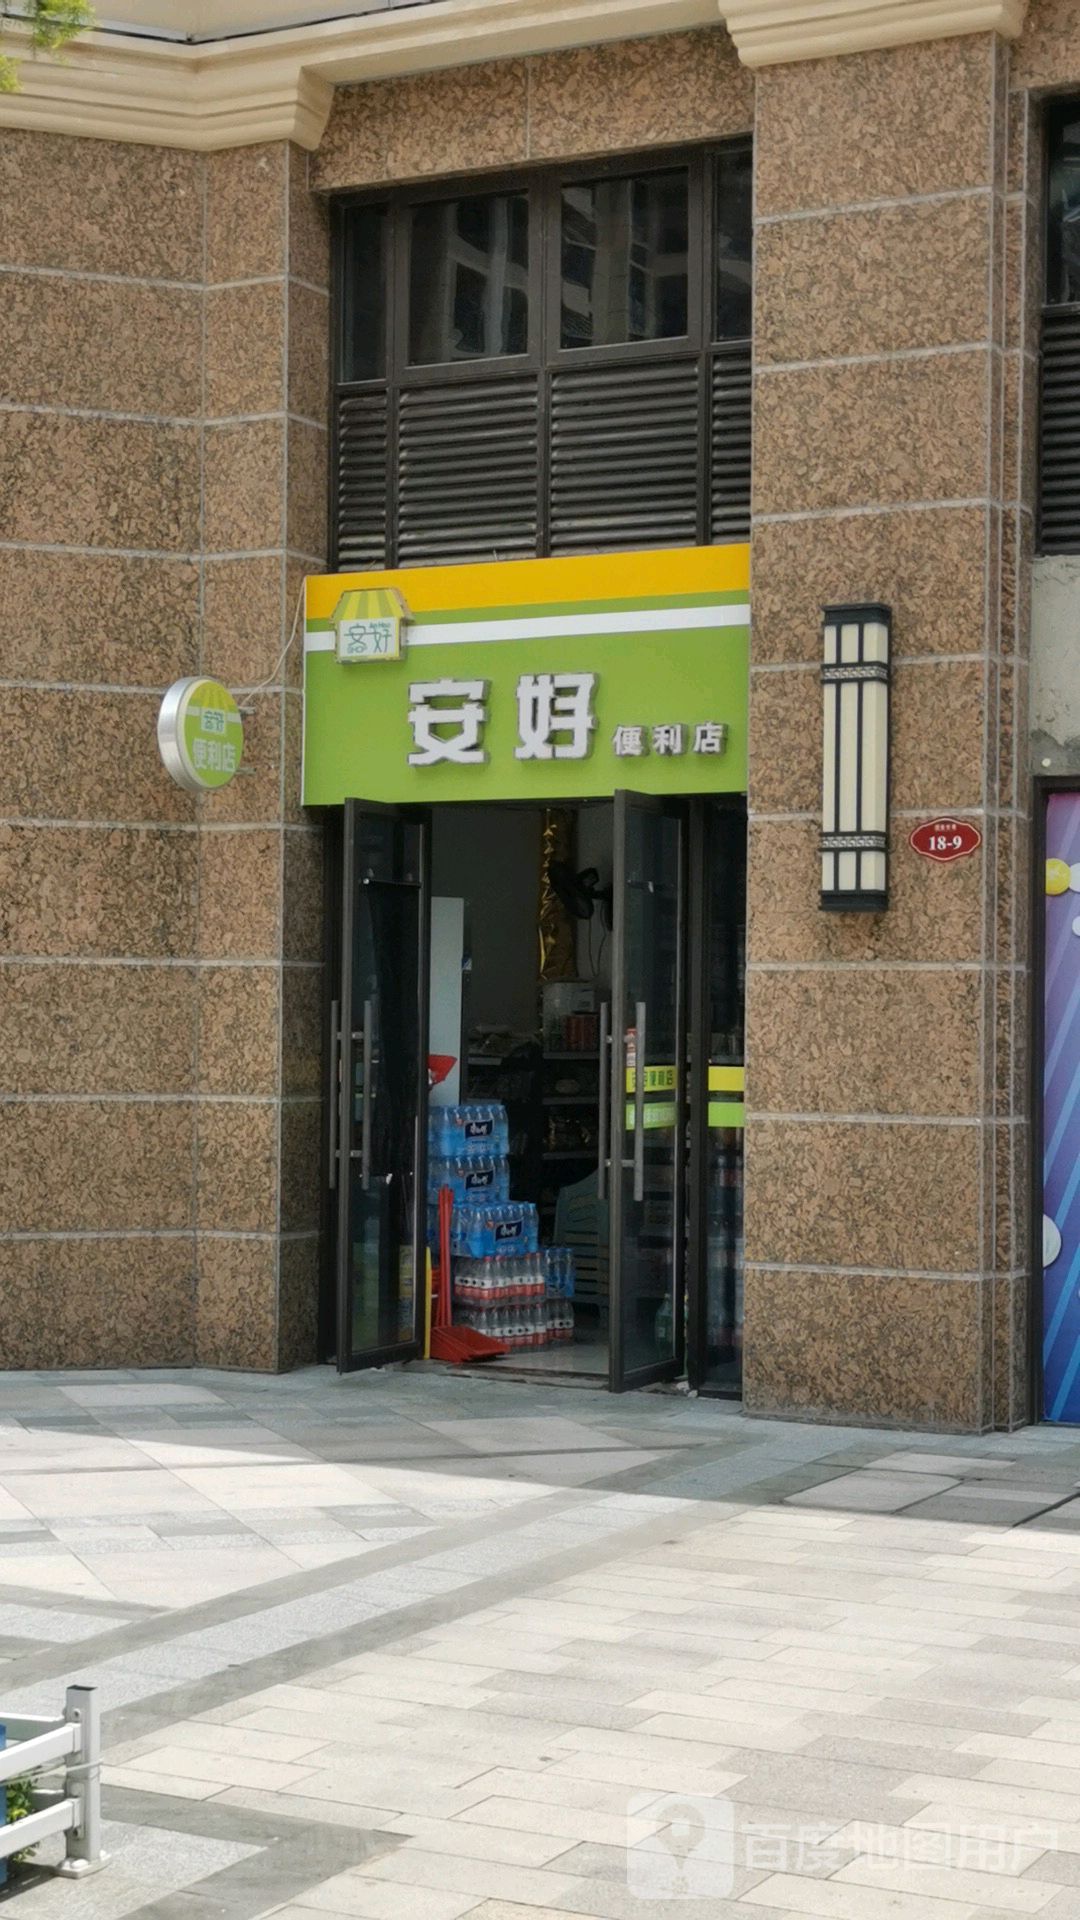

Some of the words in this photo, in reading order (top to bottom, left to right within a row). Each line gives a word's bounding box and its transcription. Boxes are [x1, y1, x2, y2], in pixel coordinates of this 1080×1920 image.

[408, 673, 597, 766] 安好
[612, 722, 727, 757] 便利店
[929, 835, 963, 851] 18-9
